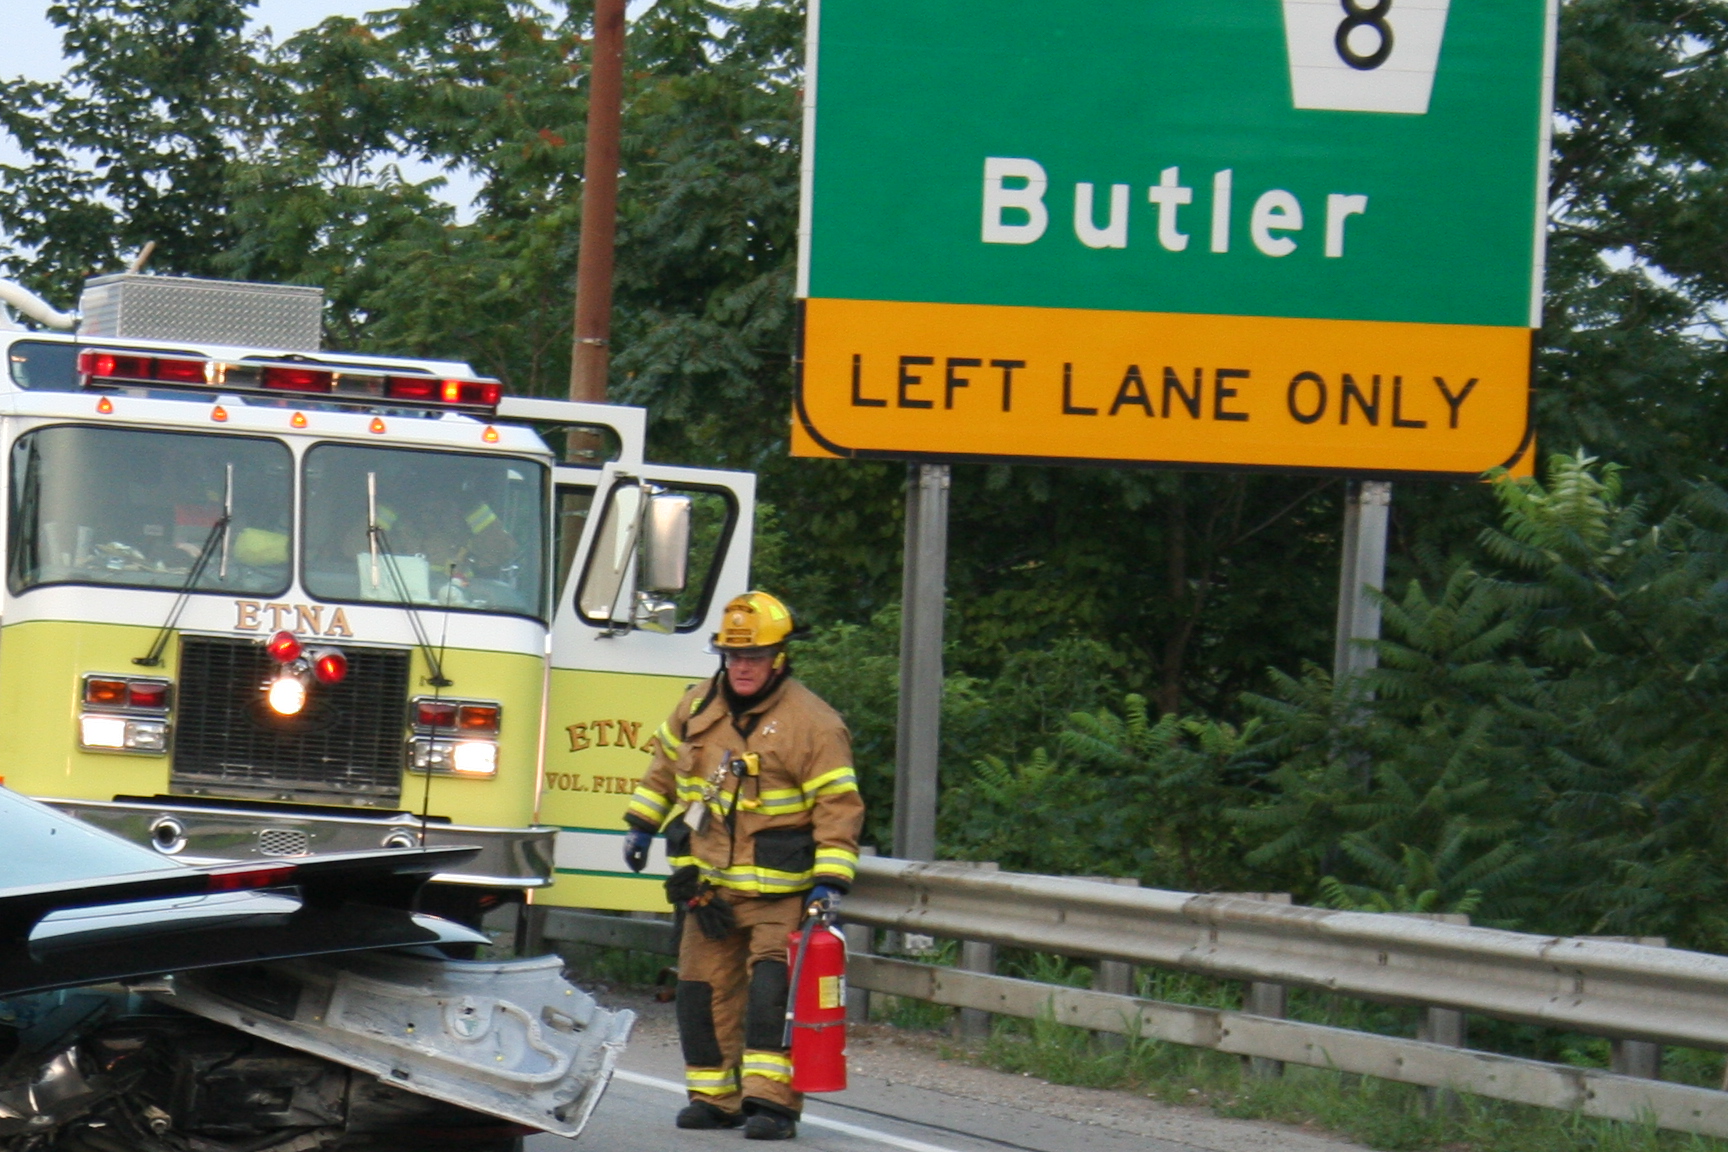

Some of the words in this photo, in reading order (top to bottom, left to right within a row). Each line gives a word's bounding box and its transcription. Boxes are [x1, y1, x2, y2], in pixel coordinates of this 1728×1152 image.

[1334, 0, 1394, 71] 8
[981, 156, 1368, 259] Butler
[850, 354, 1026, 412] LEFT
[1061, 362, 1251, 422] LANE
[1286, 370, 1479, 430] ONLY
[235, 600, 355, 637] ETNA
[546, 772, 588, 792] VOL.
